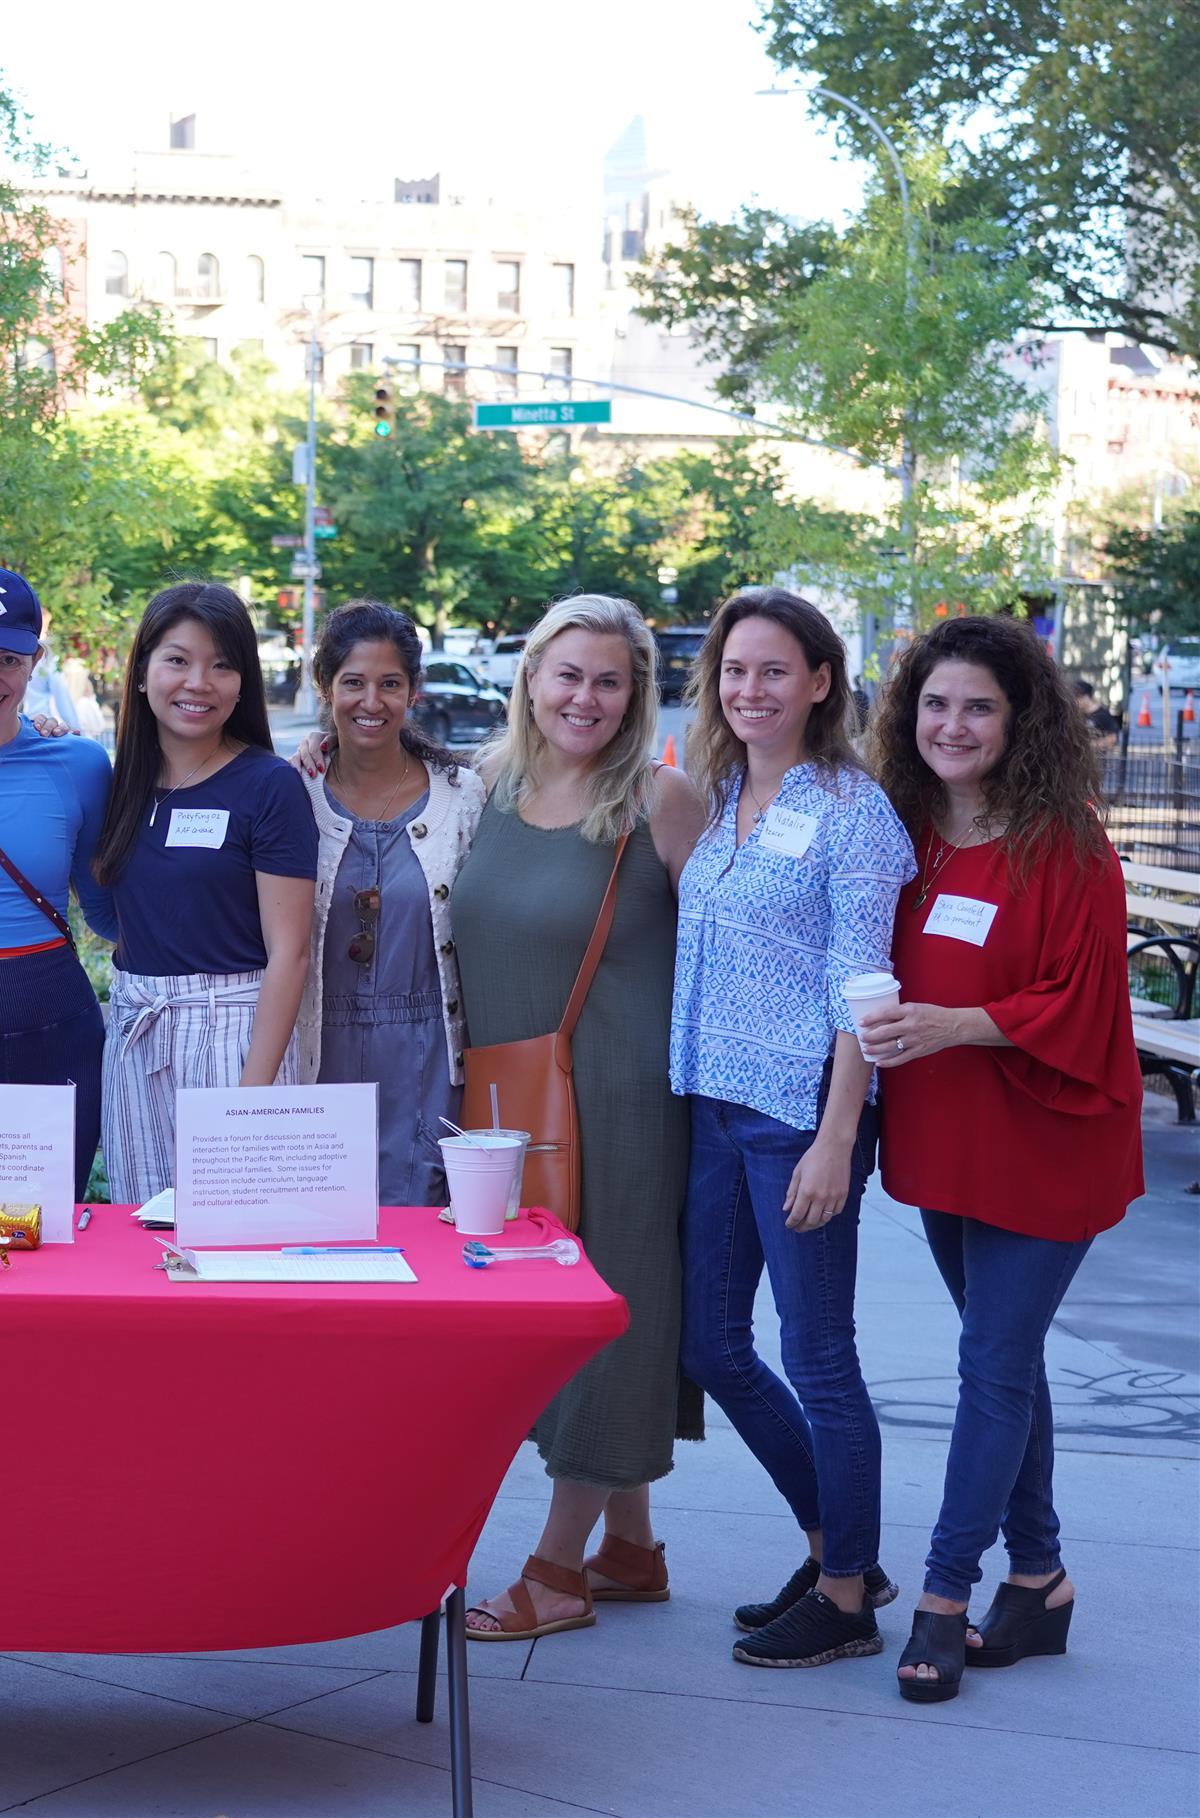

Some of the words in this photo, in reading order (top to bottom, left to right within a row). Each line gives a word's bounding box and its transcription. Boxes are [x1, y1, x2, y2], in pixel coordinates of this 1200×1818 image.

[511, 407, 557, 422] Minetta
[560, 406, 575, 421] St
[225, 1108, 290, 1116] ASIAN-AMERICAN
[292, 1107, 325, 1115] FAMILIES
[22, 1131, 31, 1139] all
[192, 1134, 223, 1142] Provides
[252, 1133, 263, 1141] for
[263, 1132, 301, 1140] discussion
[11, 1143, 38, 1152] parents
[242, 1144, 270, 1152] families
[192, 1156, 230, 1166] throughout
[269, 1154, 285, 1162] Rim,
[285, 1153, 317, 1163] including
[318, 1153, 348, 1162] adoptive
[7, 1163, 45, 1171] coordinate
[206, 1166, 244, 1174] multiracial
[276, 1164, 298, 1172] Some
[321, 1163, 332, 1171] for
[192, 1177, 230, 1185] discussion
[231, 1176, 257, 1184] include
[257, 1175, 296, 1184] curriculum,
[296, 1174, 328, 1184] language
[259, 1186, 299, 1194] recruitment
[206, 1198, 234, 1206] cultural
